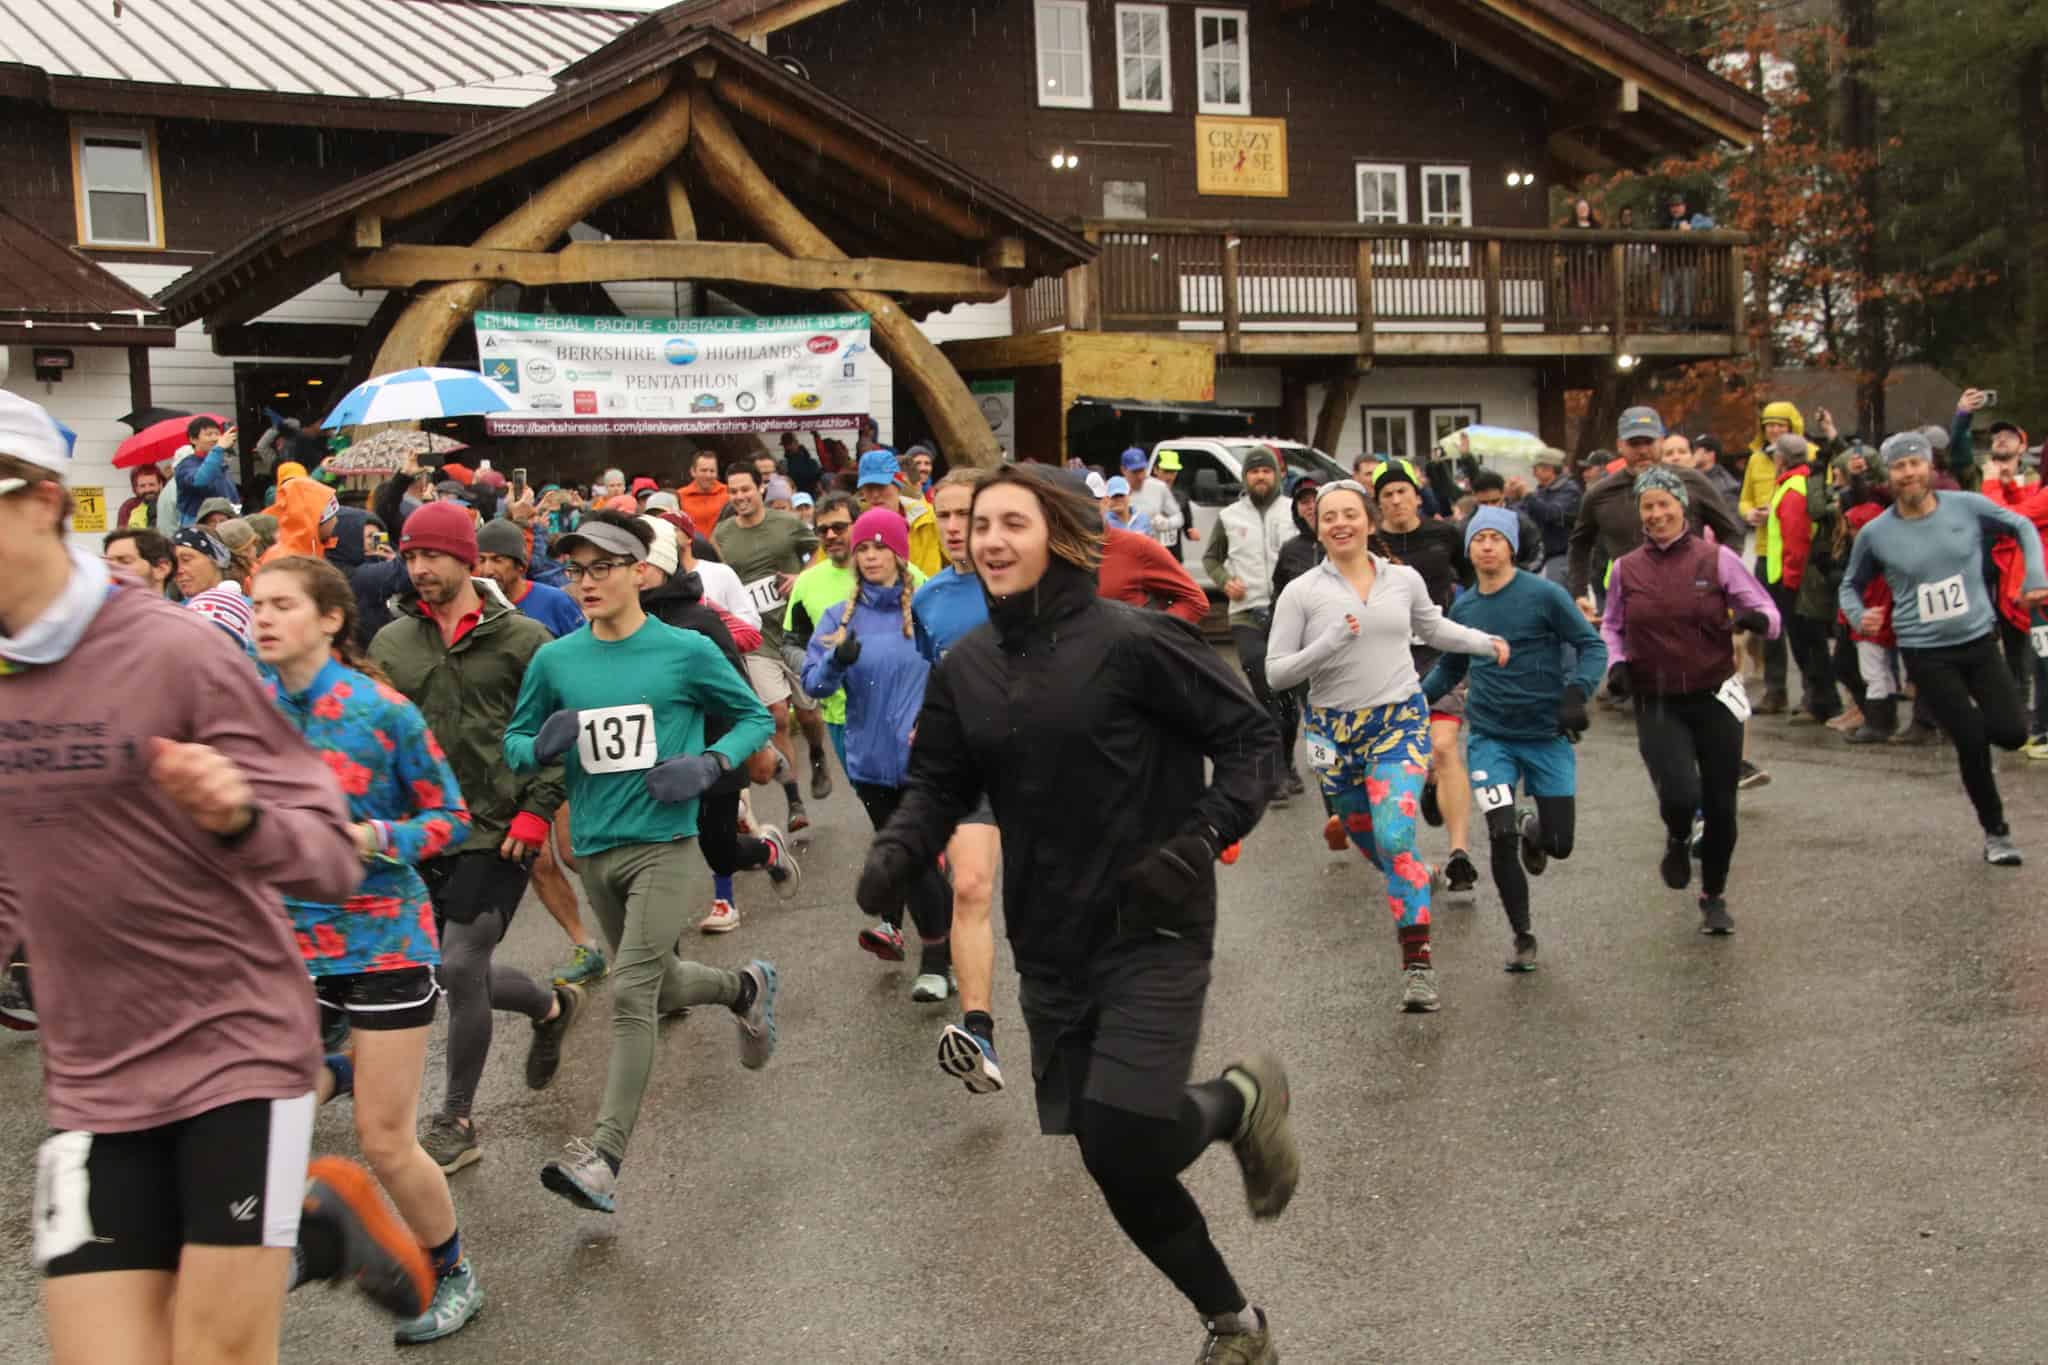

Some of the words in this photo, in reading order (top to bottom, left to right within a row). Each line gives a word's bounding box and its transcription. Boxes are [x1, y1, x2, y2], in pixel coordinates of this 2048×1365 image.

[1208, 127, 1273, 150] CRAZY
[484, 315, 520, 329] RUN
[594, 319, 652, 332] PADDLE
[667, 319, 741, 332] OBSTACLE
[755, 317, 814, 330] SUMMIT
[556, 346, 657, 362] BERKSHIRE
[706, 343, 802, 361] HIGHLANDS
[626, 373, 739, 391] PENTATHLON
[750, 581, 783, 608] 110
[1925, 584, 1963, 614] 112
[585, 714, 646, 761] 137
